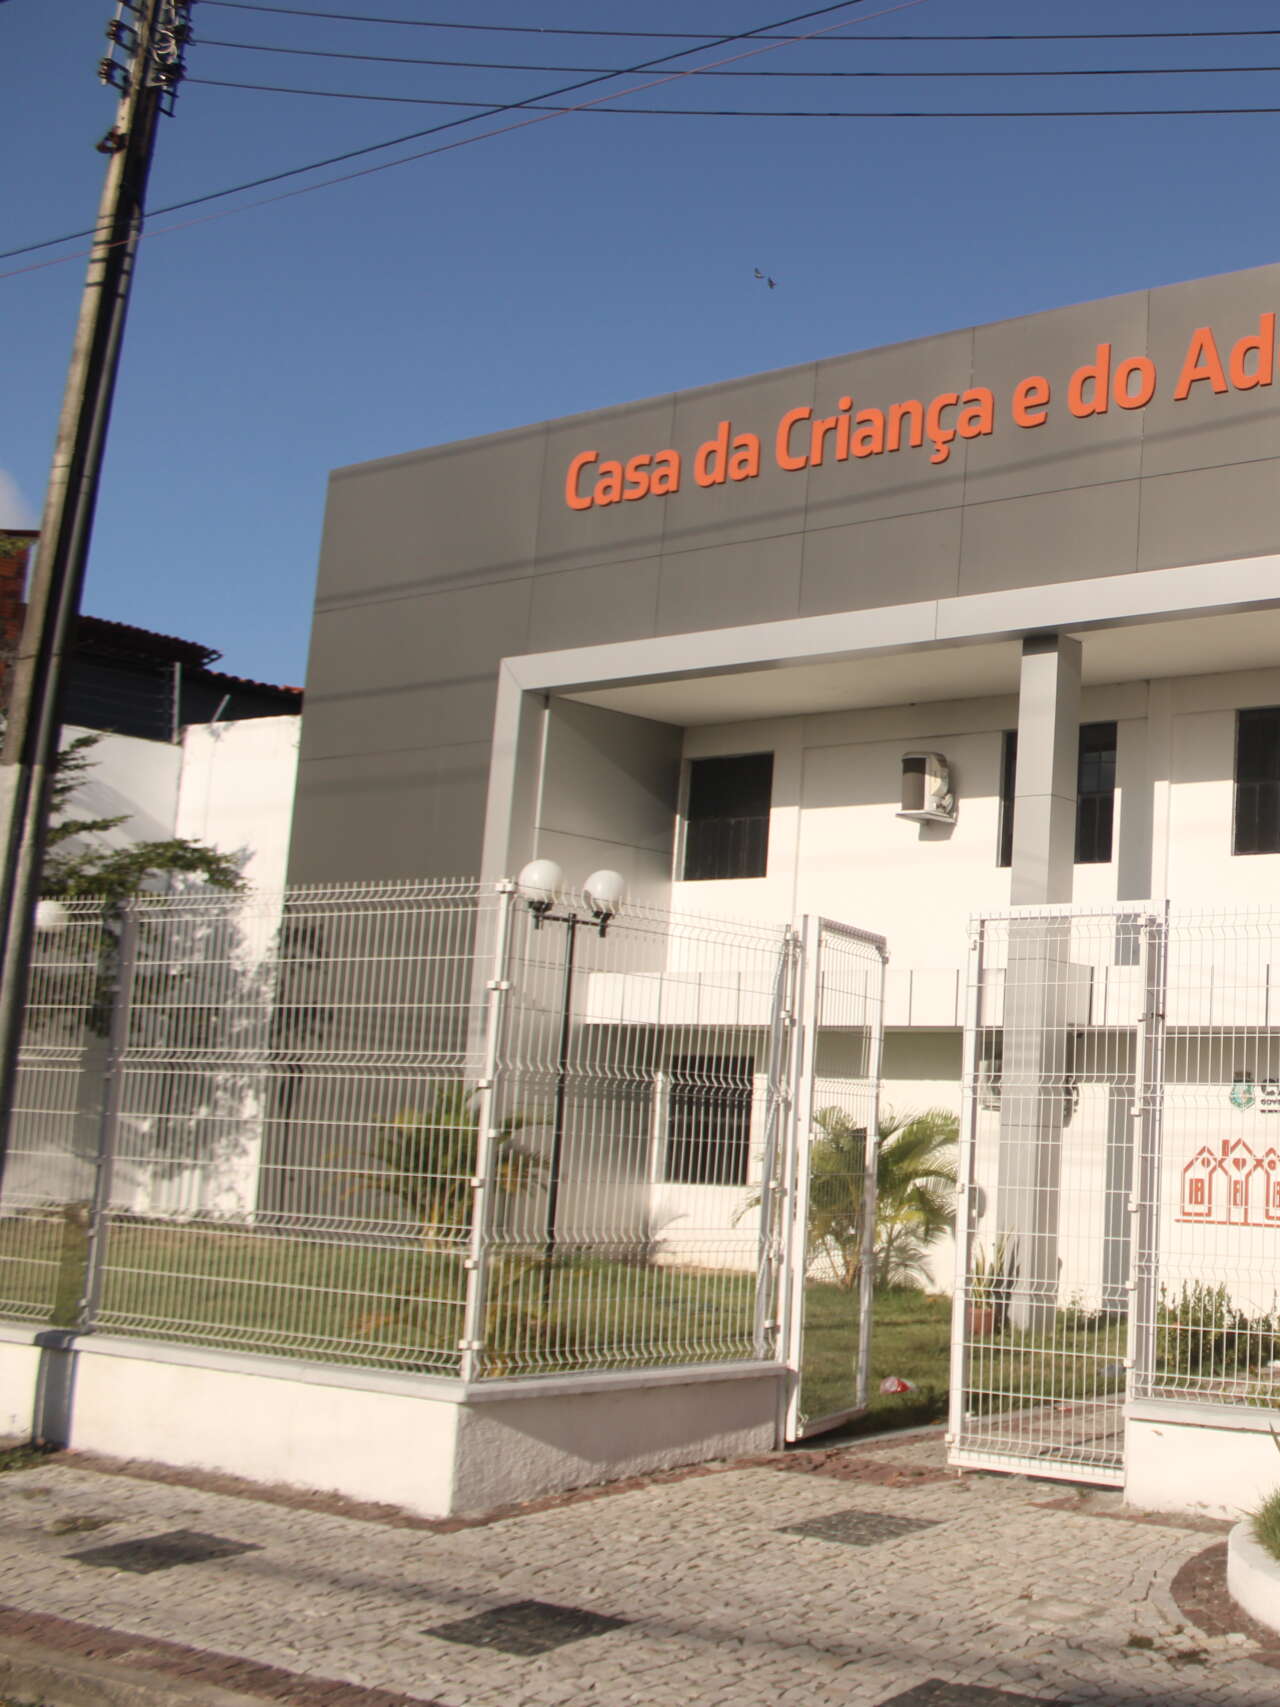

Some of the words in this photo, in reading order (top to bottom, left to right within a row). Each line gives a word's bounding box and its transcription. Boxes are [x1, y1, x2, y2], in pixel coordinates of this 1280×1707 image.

[566, 449, 682, 511] Casa
[695, 421, 761, 488] da
[776, 396, 995, 465] Criança
[1012, 376, 1051, 429] e
[1067, 343, 1158, 418] do
